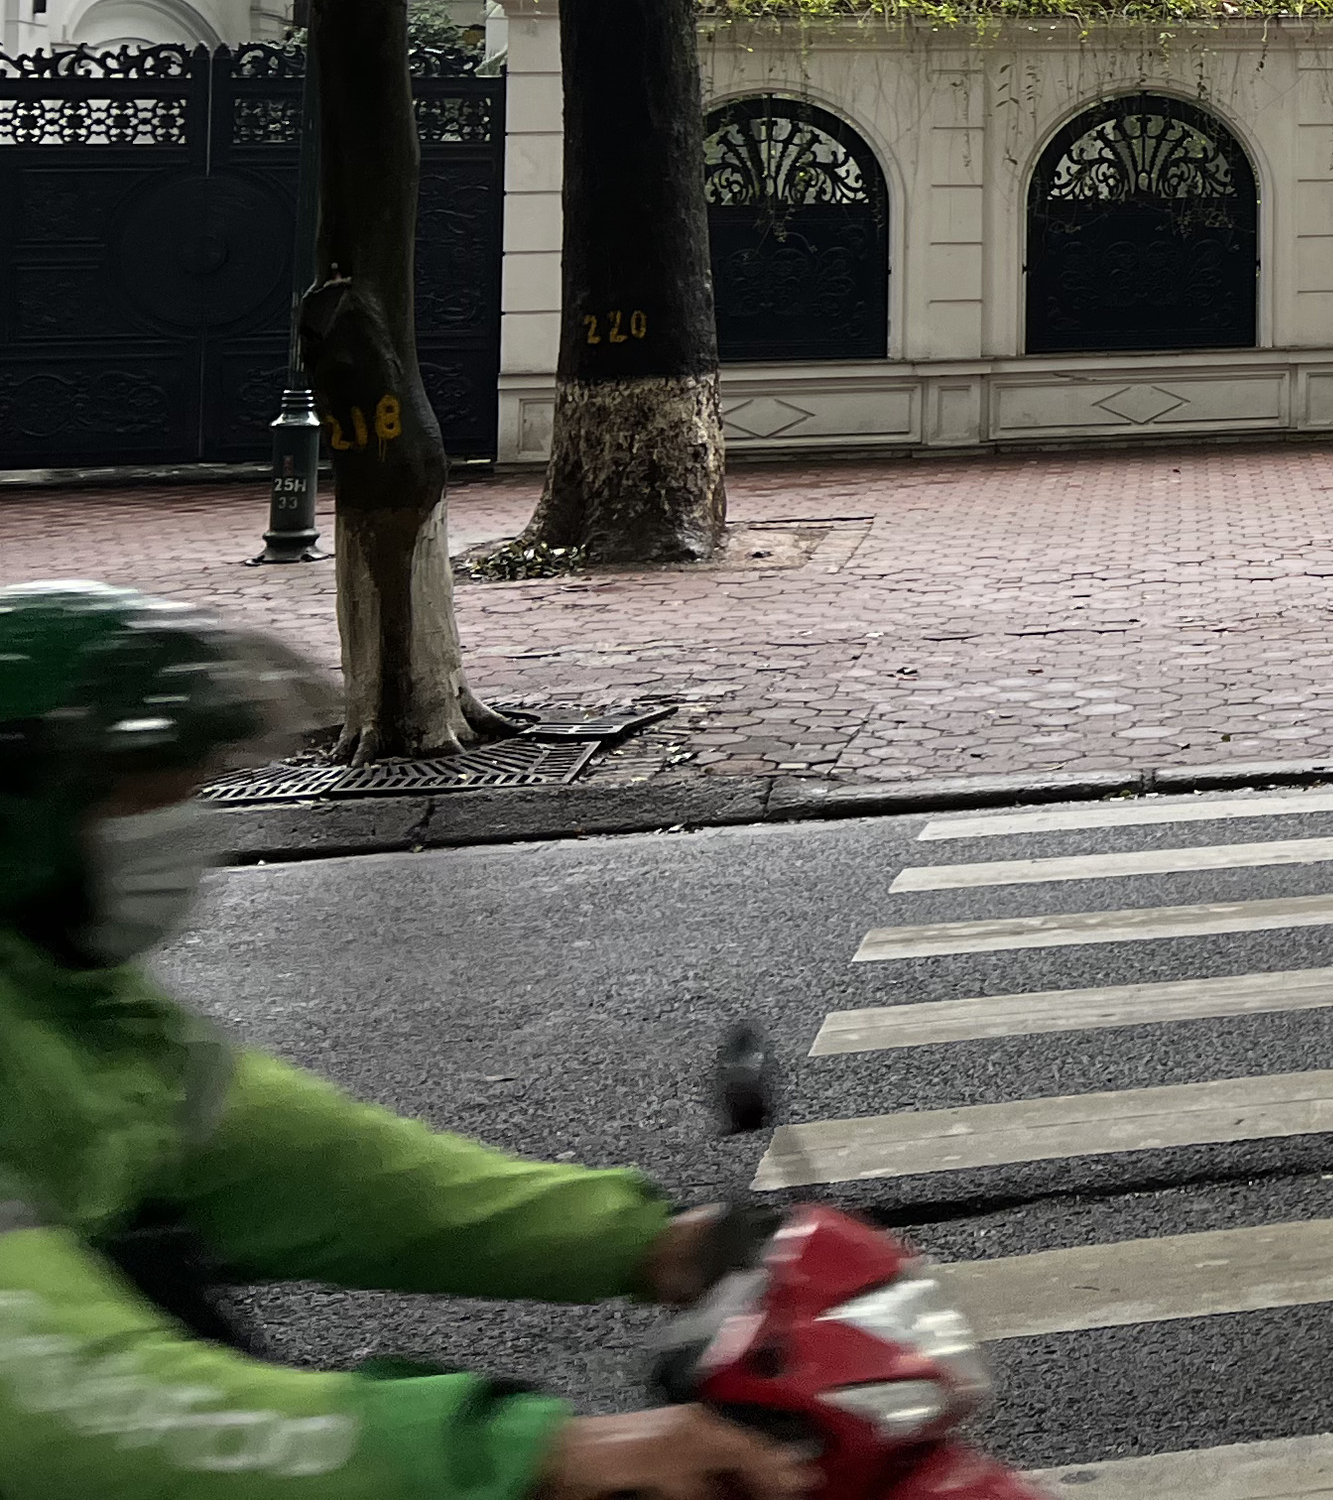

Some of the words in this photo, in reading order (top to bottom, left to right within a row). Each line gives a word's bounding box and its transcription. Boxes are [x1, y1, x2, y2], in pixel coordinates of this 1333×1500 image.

[583, 309, 648, 345] 220
[325, 393, 403, 452] 218
[273, 477, 307, 493] 25H
[278, 496, 298, 510] 33
